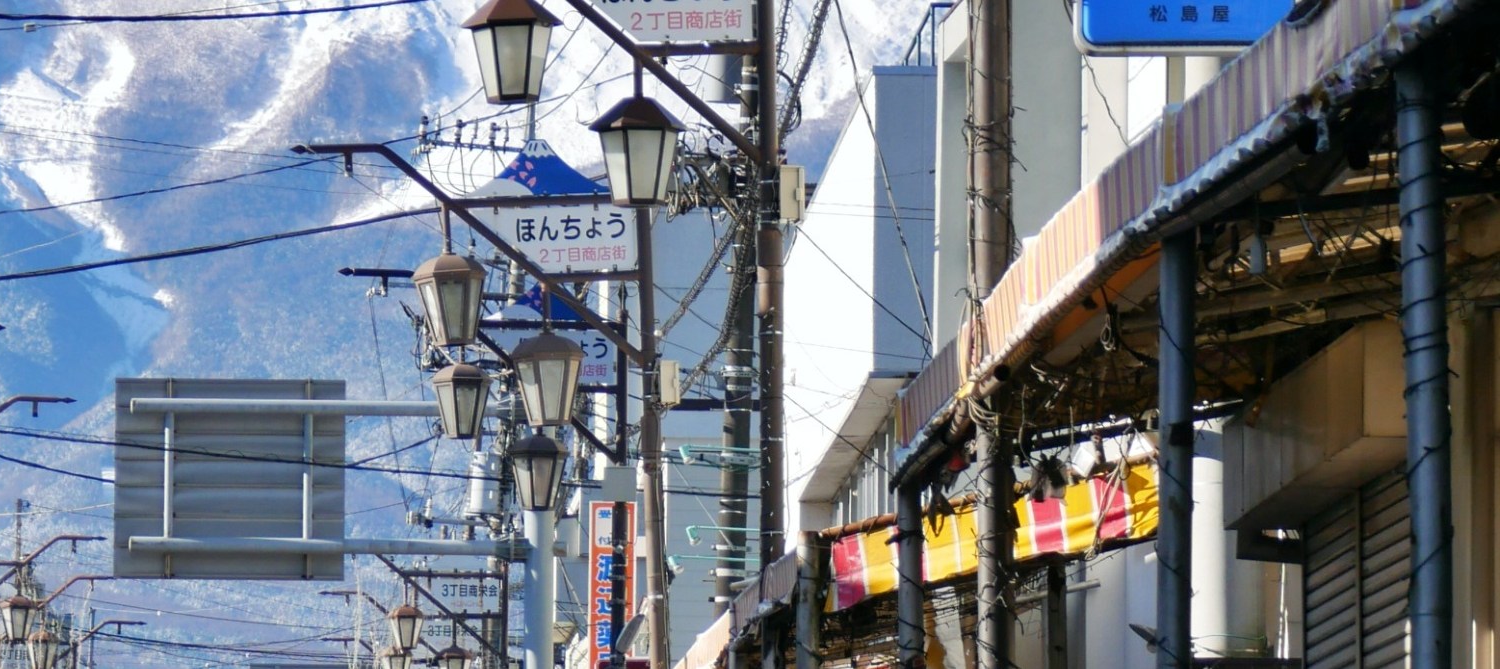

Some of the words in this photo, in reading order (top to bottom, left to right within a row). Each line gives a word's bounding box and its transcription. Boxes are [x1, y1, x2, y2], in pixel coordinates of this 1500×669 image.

[630, 9, 743, 31] 2丁目商店街
[1149, 5, 1230, 23] 松島屋
[516, 212, 626, 242] ほんちょう
[539, 245, 627, 264] 2丁目商店街
